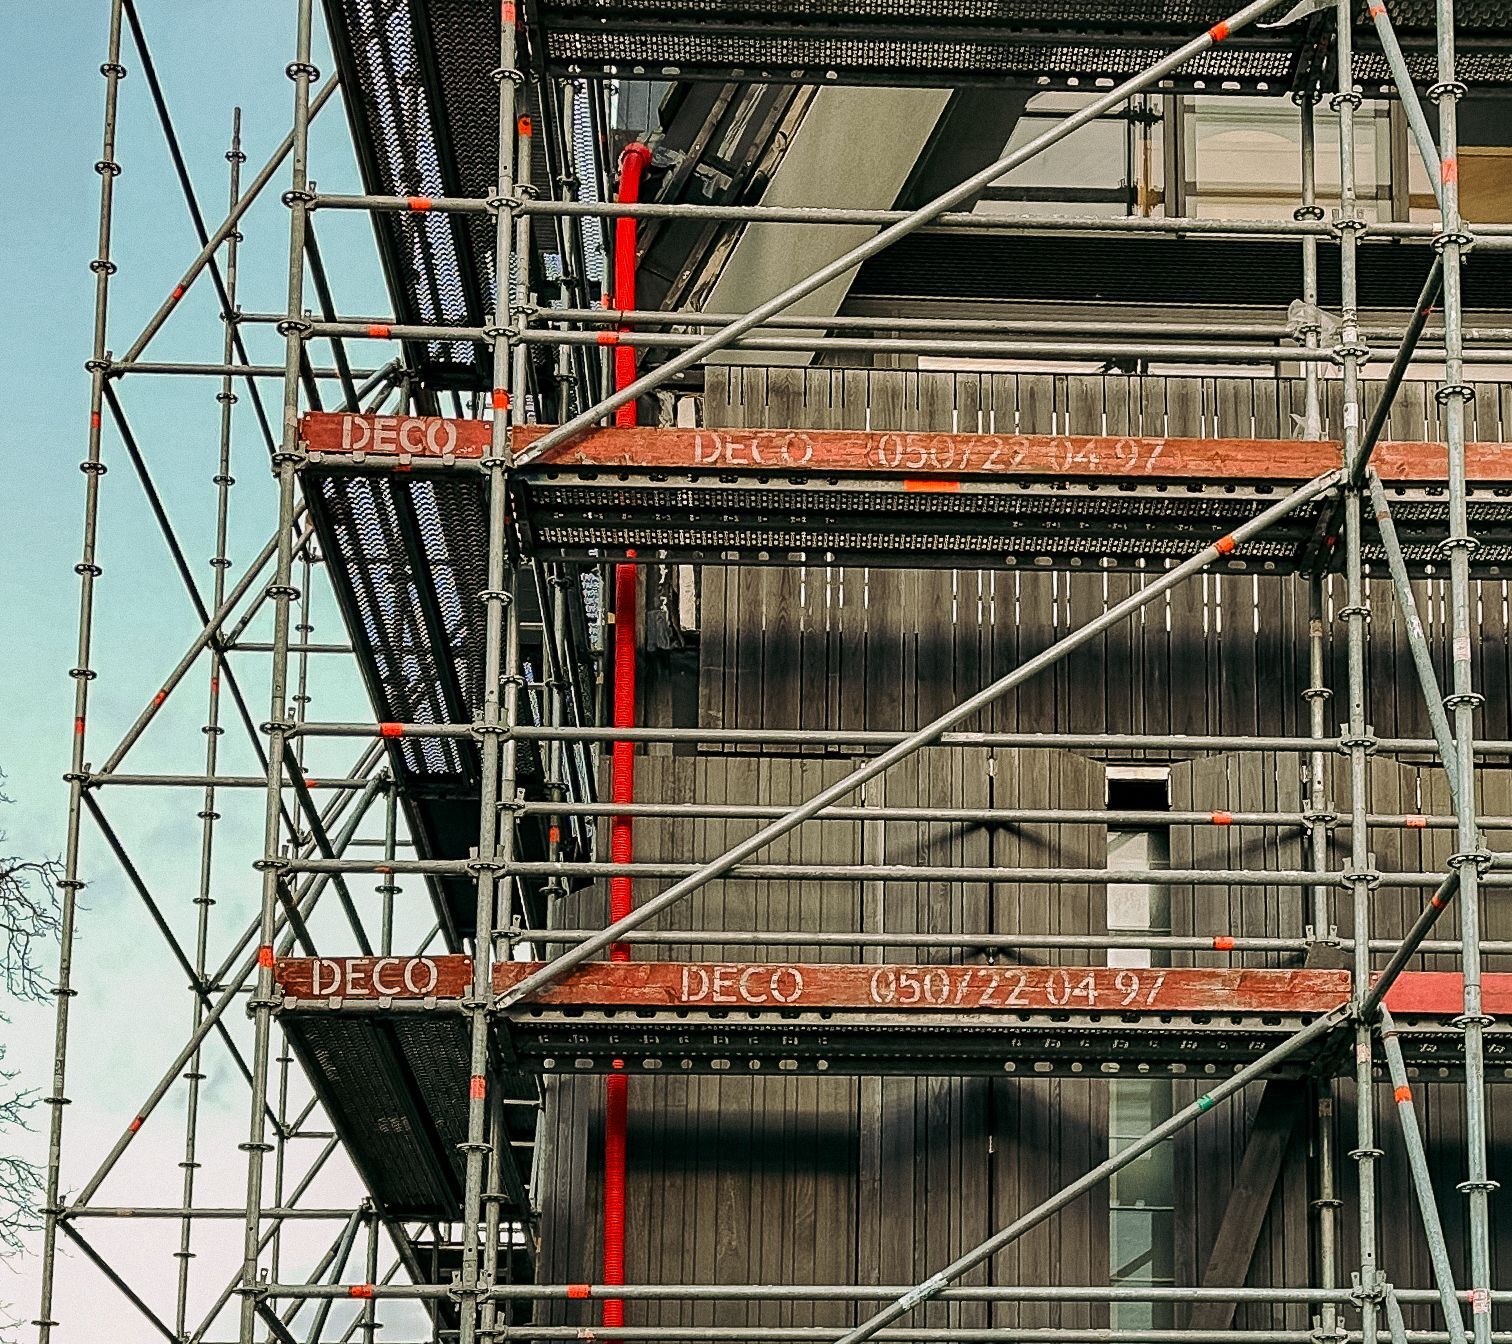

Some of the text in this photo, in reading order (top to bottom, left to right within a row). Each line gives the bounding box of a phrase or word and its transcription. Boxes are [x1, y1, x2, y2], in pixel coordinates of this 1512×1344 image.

[342, 416, 457, 454] DECO
[694, 434, 813, 465] DECO
[312, 958, 438, 996] DECO
[681, 967, 804, 1002] DECO
[871, 969, 1031, 1005] 050/22
[1045, 971, 1099, 1006] 04
